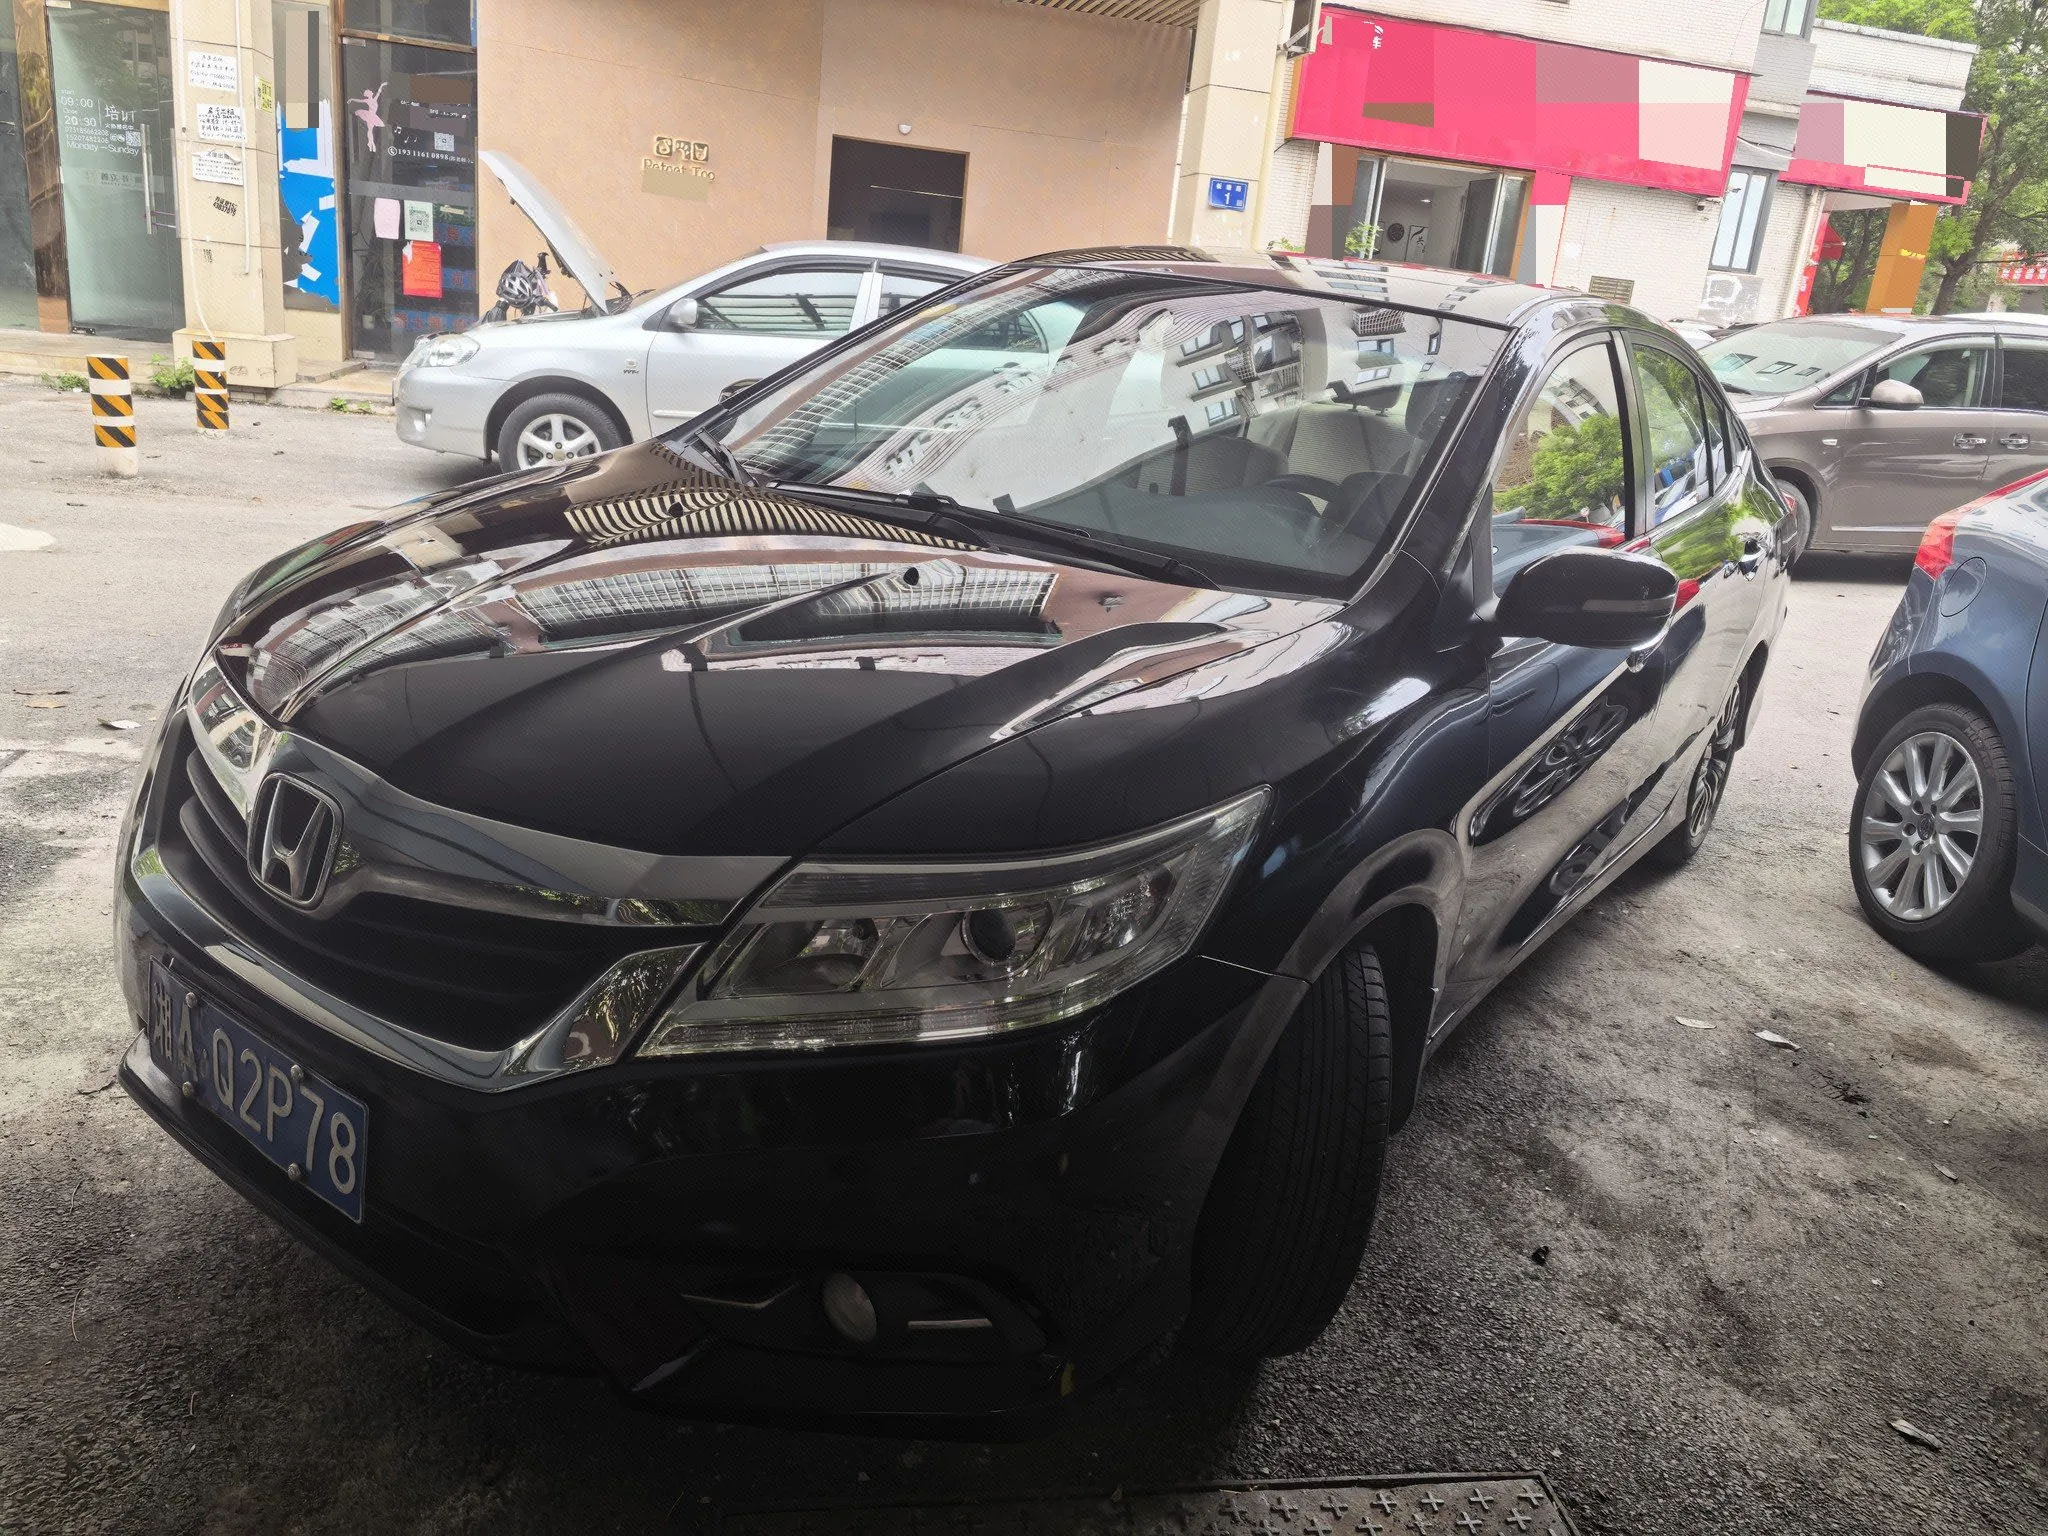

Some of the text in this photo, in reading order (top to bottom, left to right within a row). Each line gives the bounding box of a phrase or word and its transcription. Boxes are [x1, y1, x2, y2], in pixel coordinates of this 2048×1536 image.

[104, 104, 137, 122] 培训
[413, 150, 430, 158] 1161
[431, 152, 449, 160] 0898
[1224, 192, 1231, 205] 1
